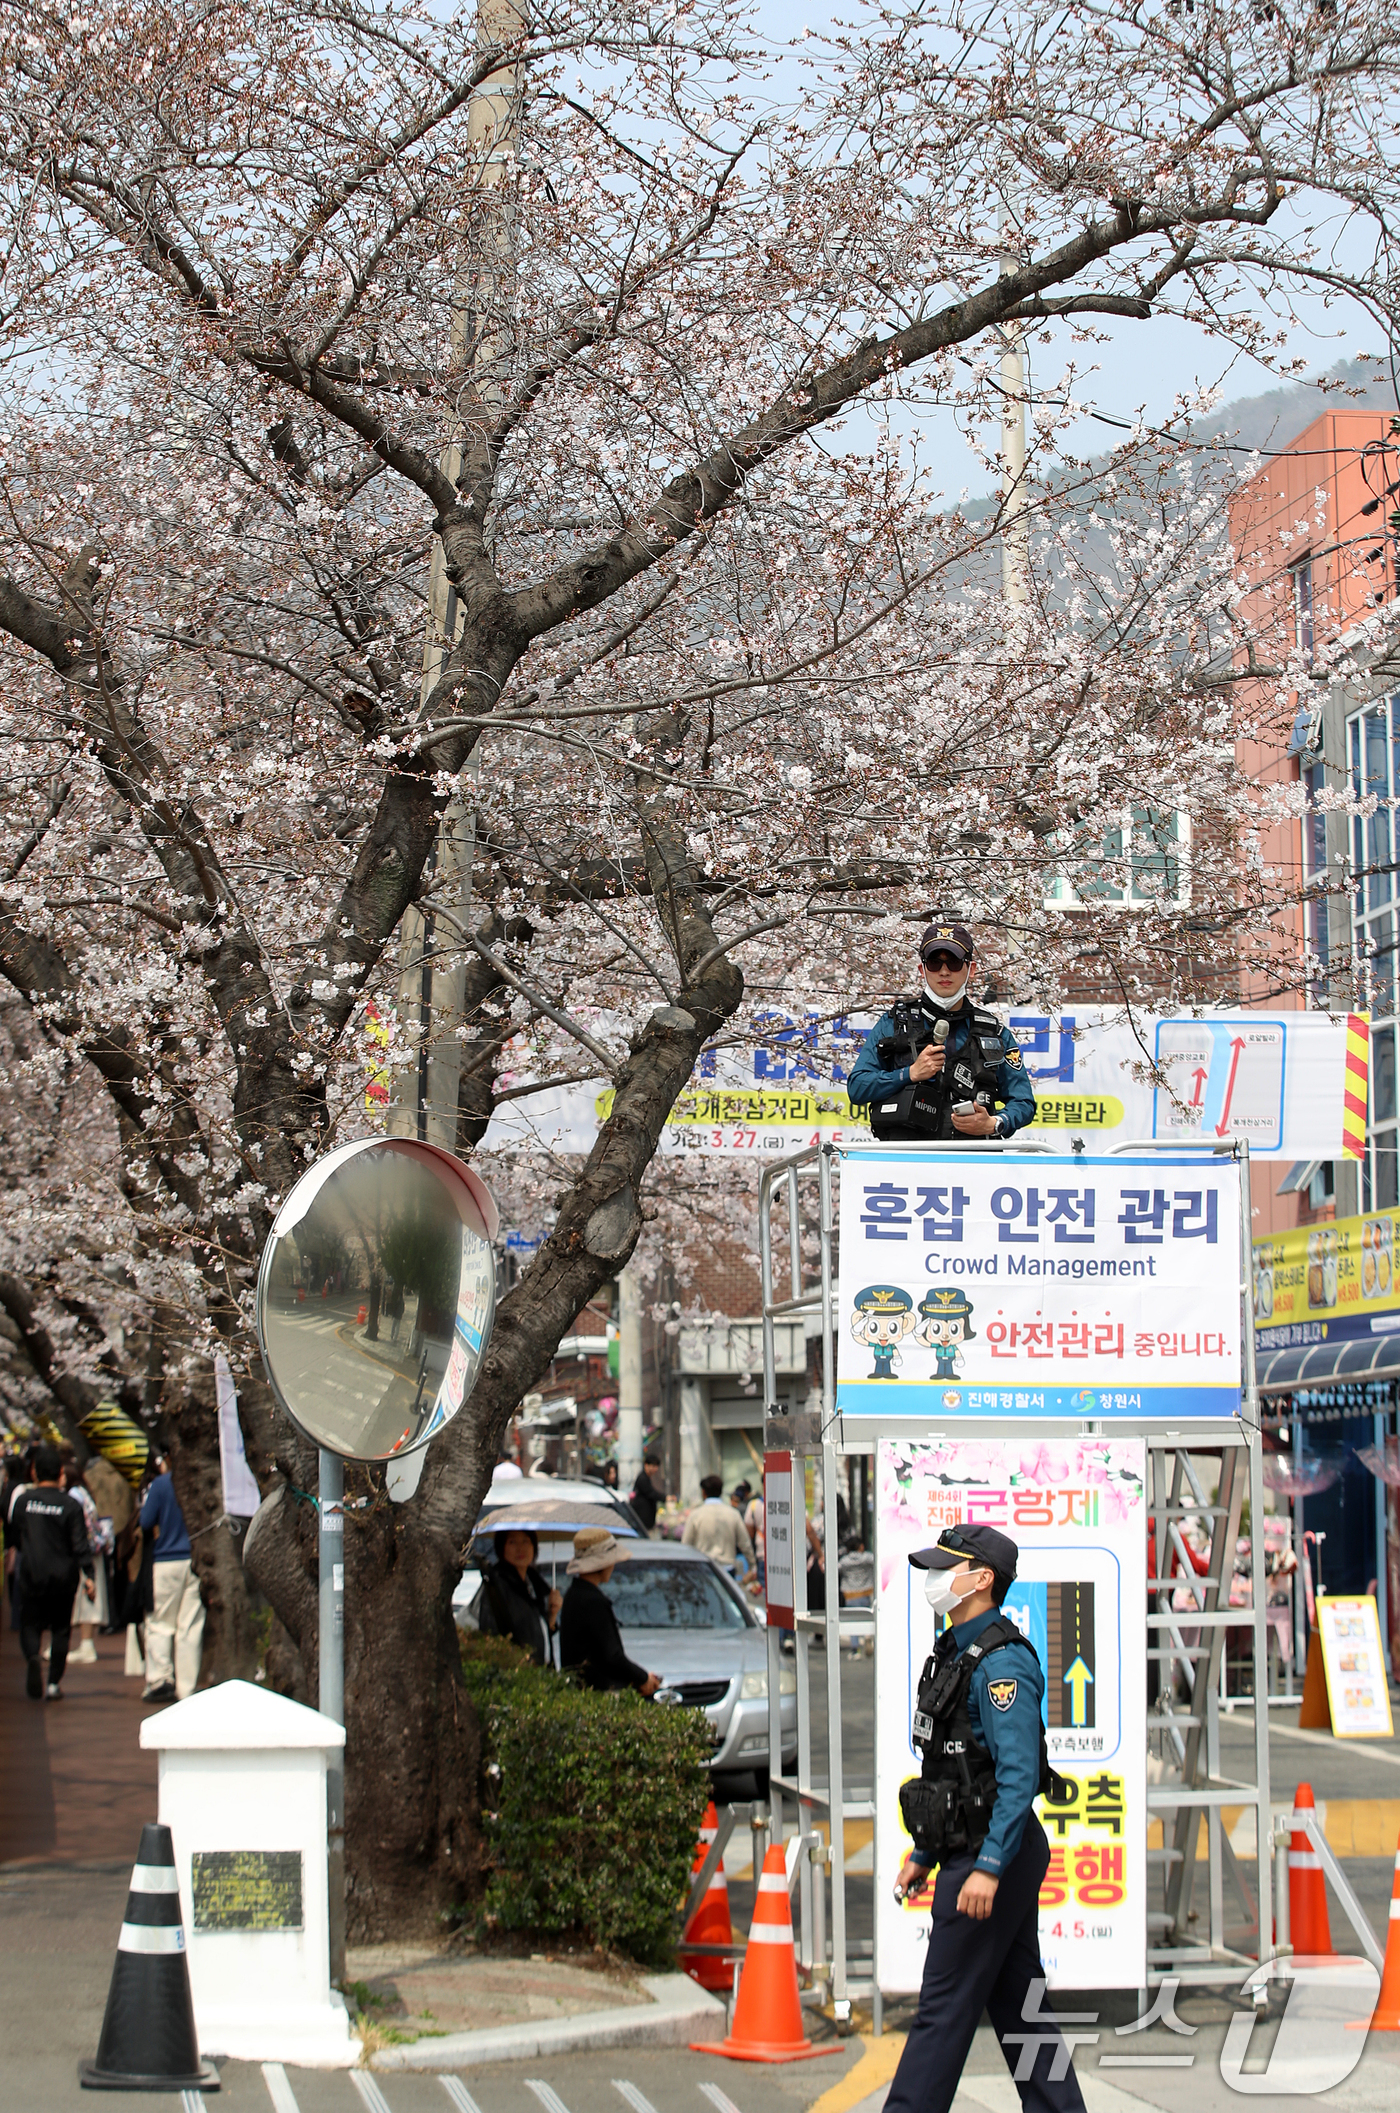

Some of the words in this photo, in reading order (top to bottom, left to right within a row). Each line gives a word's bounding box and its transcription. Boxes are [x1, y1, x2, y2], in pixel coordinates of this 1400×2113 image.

[860, 1182, 971, 1243] 혼잡
[990, 1187, 1097, 1244] 안전
[1117, 1188, 1219, 1245] 관리
[924, 1253, 999, 1276] Crowd
[1007, 1254, 1157, 1279] Management
[986, 1321, 1125, 1359] 안전관리
[1133, 1332, 1233, 1358] 중입니다.
[967, 1392, 1045, 1409] 진해경찰서
[1099, 1392, 1142, 1410] 창원시
[927, 1489, 962, 1503] 제64회
[927, 1506, 962, 1527] 진해
[967, 1489, 1099, 1527] 군항제
[1050, 1736, 1105, 1752] 우측보행
